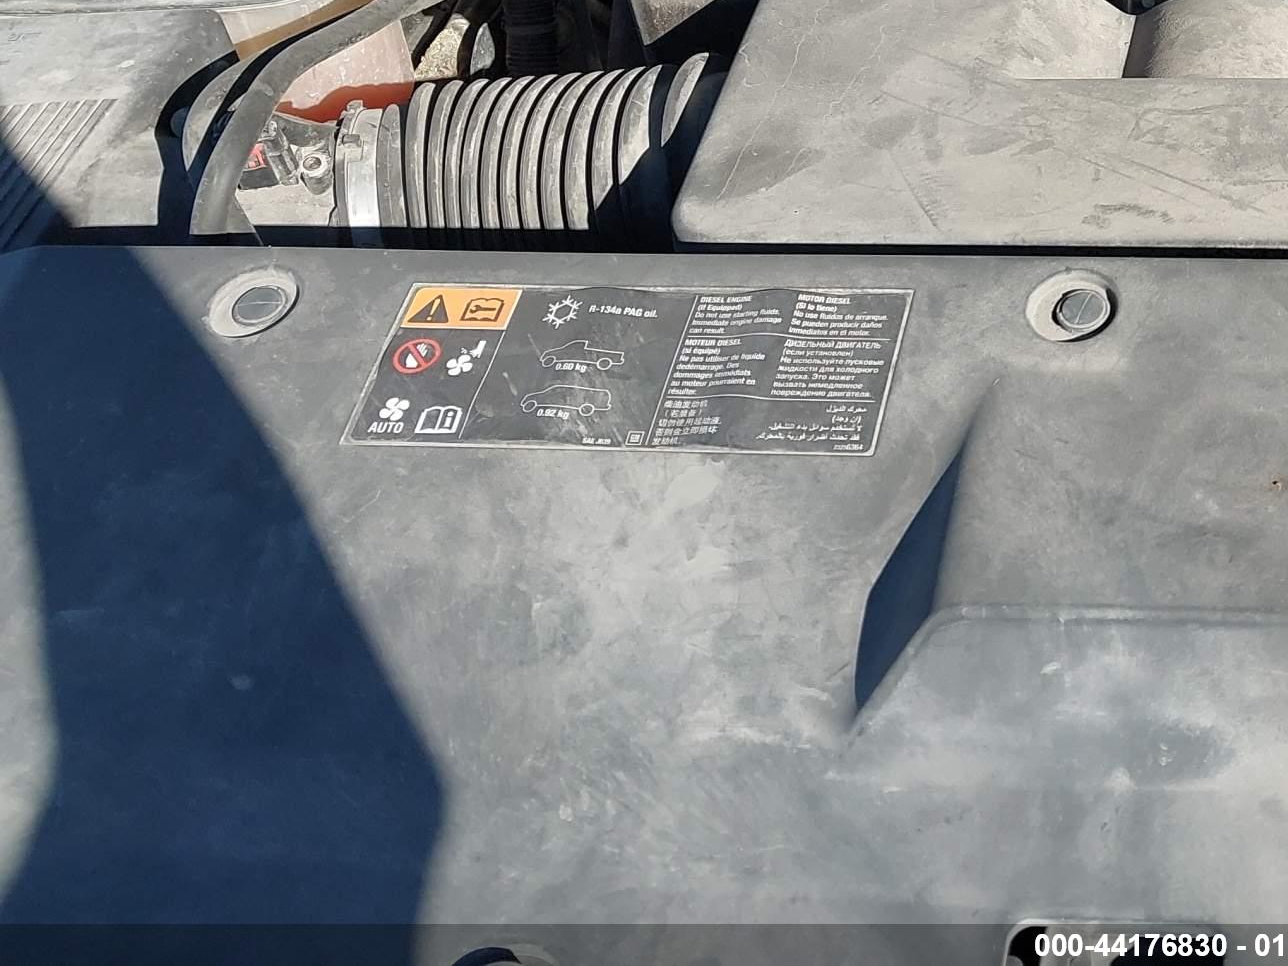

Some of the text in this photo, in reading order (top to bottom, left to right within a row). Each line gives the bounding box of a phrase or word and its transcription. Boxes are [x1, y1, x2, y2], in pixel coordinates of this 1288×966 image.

[798, 294, 825, 303] MOTOR
[589, 305, 658, 318] R-134a PAG oil.
[802, 320, 828, 328] pueden
[784, 339, 834, 348] ДИЗЕЛЬНЫЙ
[575, 363, 587, 373] kg
[673, 372, 713, 380] dommages
[708, 378, 745, 387] pourraient
[557, 409, 570, 420] kg
[367, 422, 404, 433] AUTO
